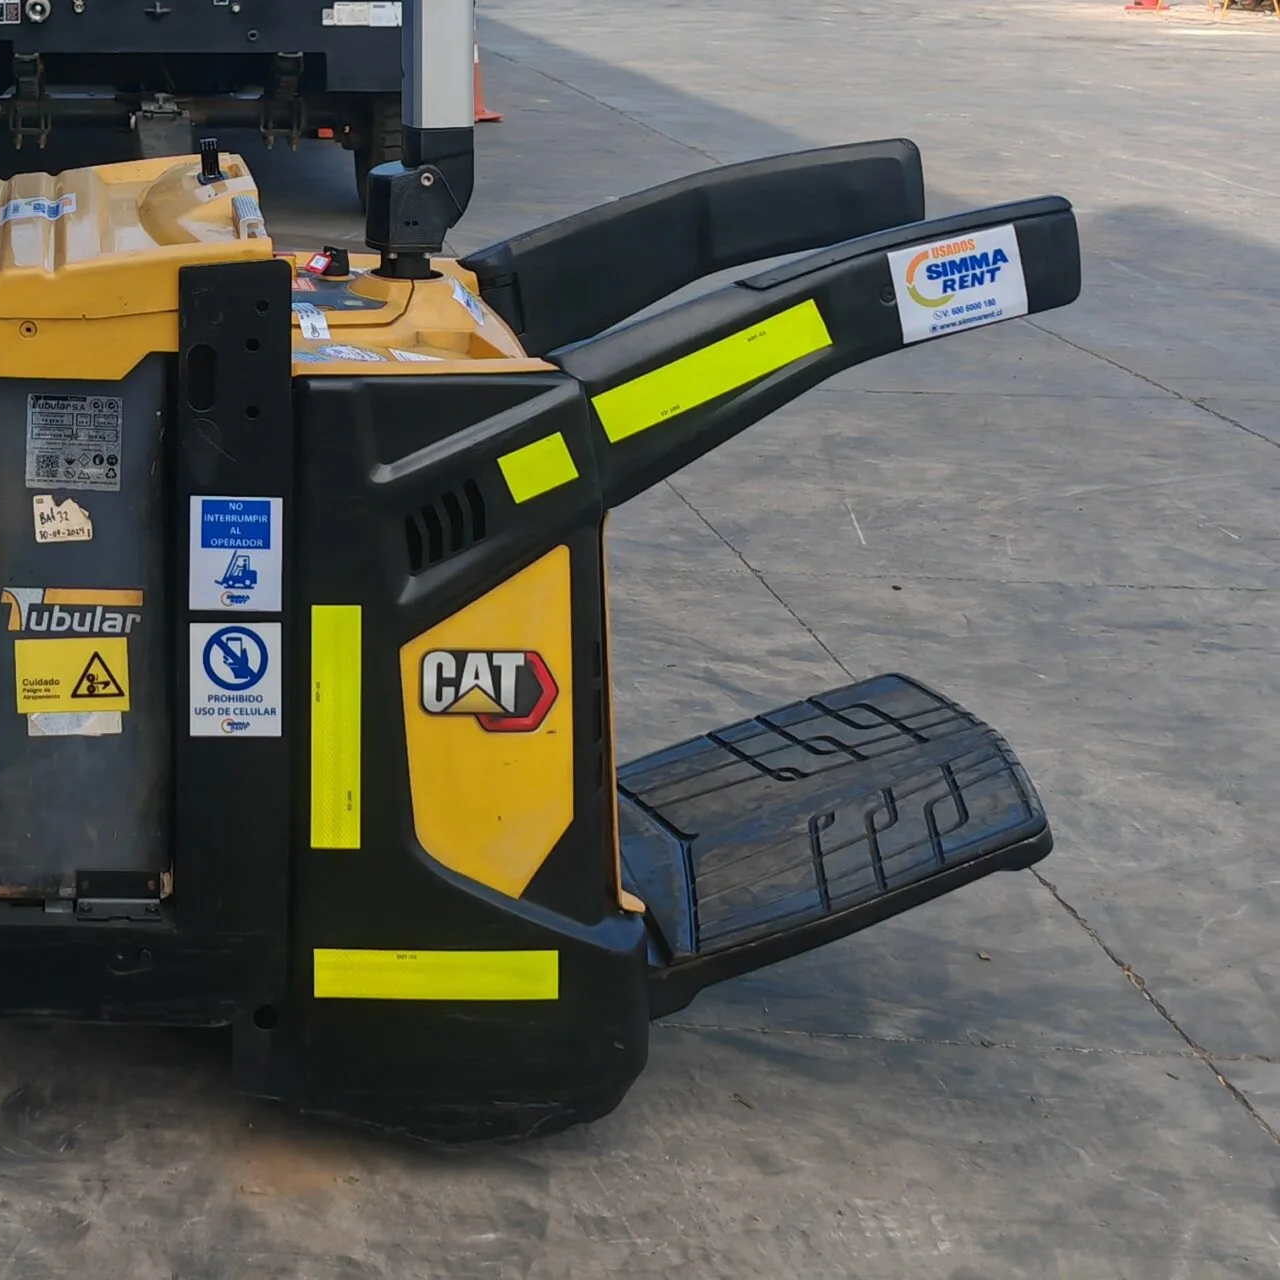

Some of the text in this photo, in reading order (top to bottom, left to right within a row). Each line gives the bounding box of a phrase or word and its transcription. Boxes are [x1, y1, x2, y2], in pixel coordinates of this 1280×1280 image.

[931, 239, 977, 259] USADOS
[926, 248, 1009, 281] SIMMA
[942, 266, 1001, 294] RENT
[228, 502, 244, 511] NO
[204, 514, 268, 523] INTERRUMPIR
[229, 526, 242, 535] AL
[210, 538, 264, 547] OPERADOR
[1, 587, 142, 634] Tubular
[22, 677, 61, 687] Cuidado
[423, 651, 525, 713] CAT
[207, 694, 264, 704] PROHIBIDO
[194, 707, 277, 716] USO DE CELULAR
